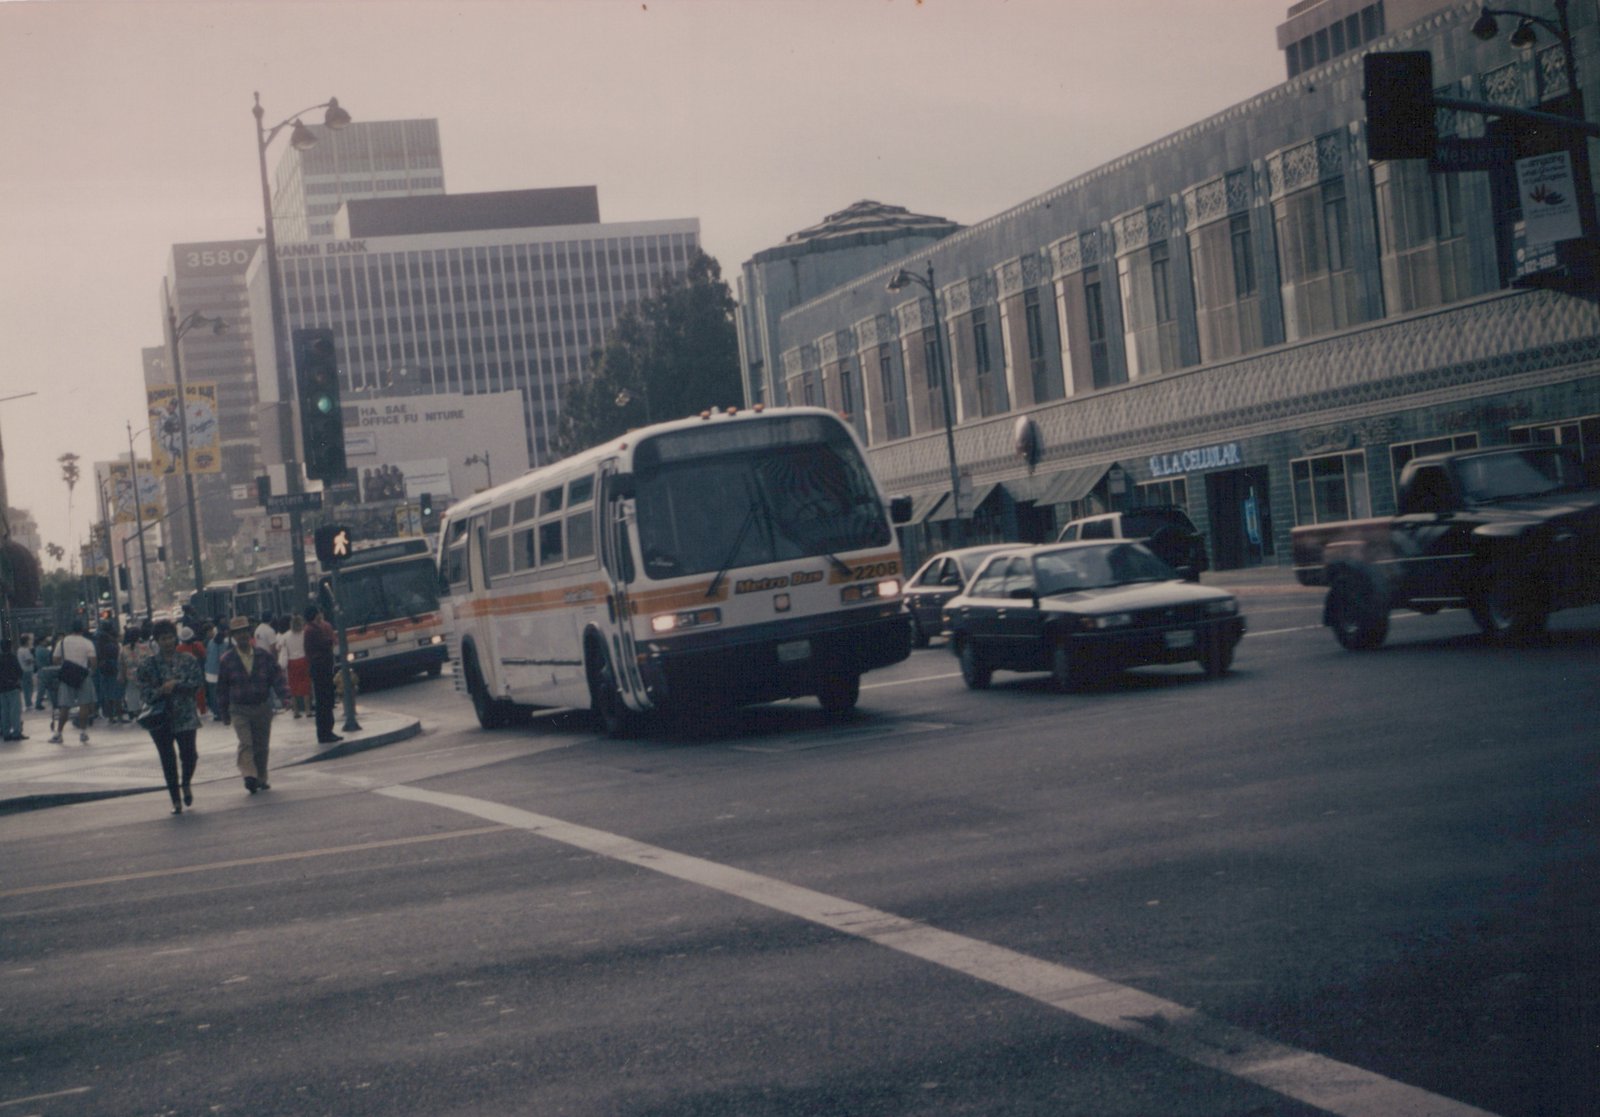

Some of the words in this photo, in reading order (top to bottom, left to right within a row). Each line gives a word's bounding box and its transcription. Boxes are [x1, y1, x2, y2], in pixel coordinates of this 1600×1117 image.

[326, 240, 368, 254] BANK
[187, 250, 248, 268] 3580
[361, 407, 378, 416] HA
[385, 404, 407, 414] SAE
[361, 415, 399, 427] OFFICE
[735, 576, 789, 594] Metro
[791, 570, 824, 587] Bus
